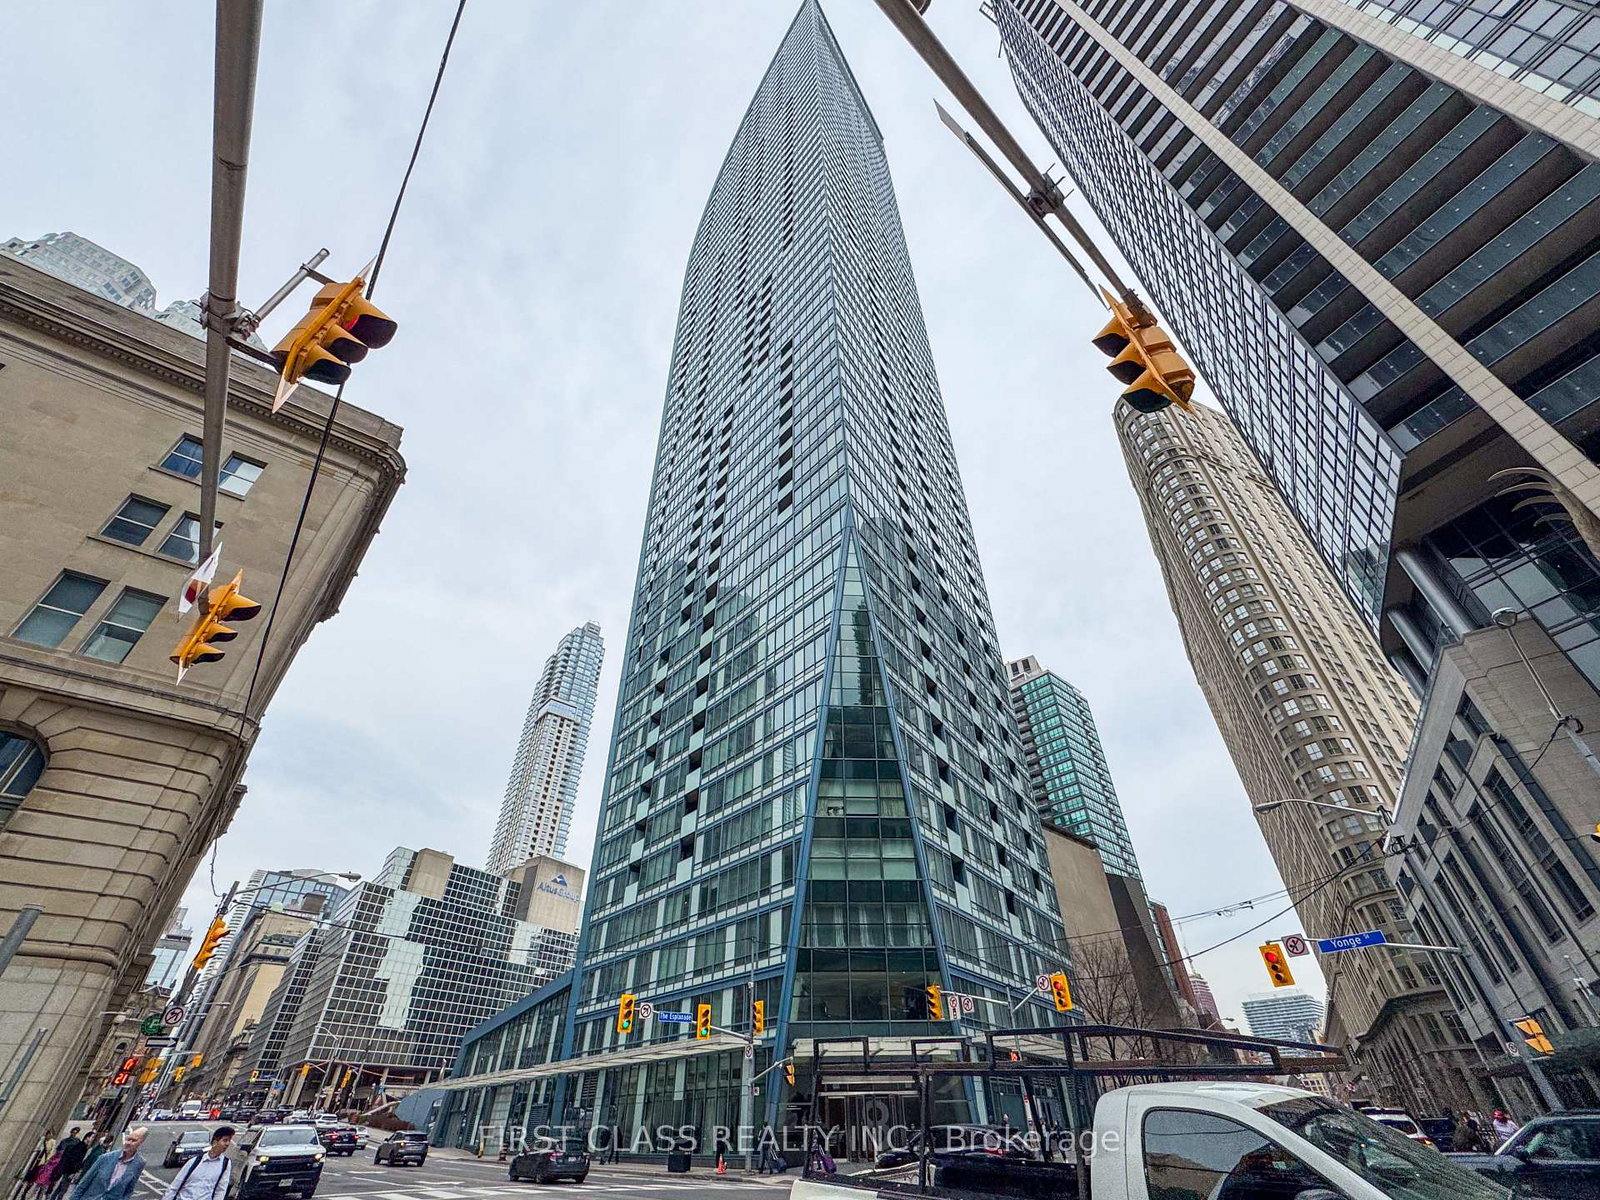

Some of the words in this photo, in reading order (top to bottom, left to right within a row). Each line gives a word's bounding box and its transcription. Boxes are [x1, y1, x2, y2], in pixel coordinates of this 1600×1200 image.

[537, 881, 558, 895] Altus
[1330, 936, 1362, 948] Yonge
[660, 1011, 669, 1019] The
[670, 1012, 692, 1021] Esplanade
[114, 1073, 128, 1084] 21
